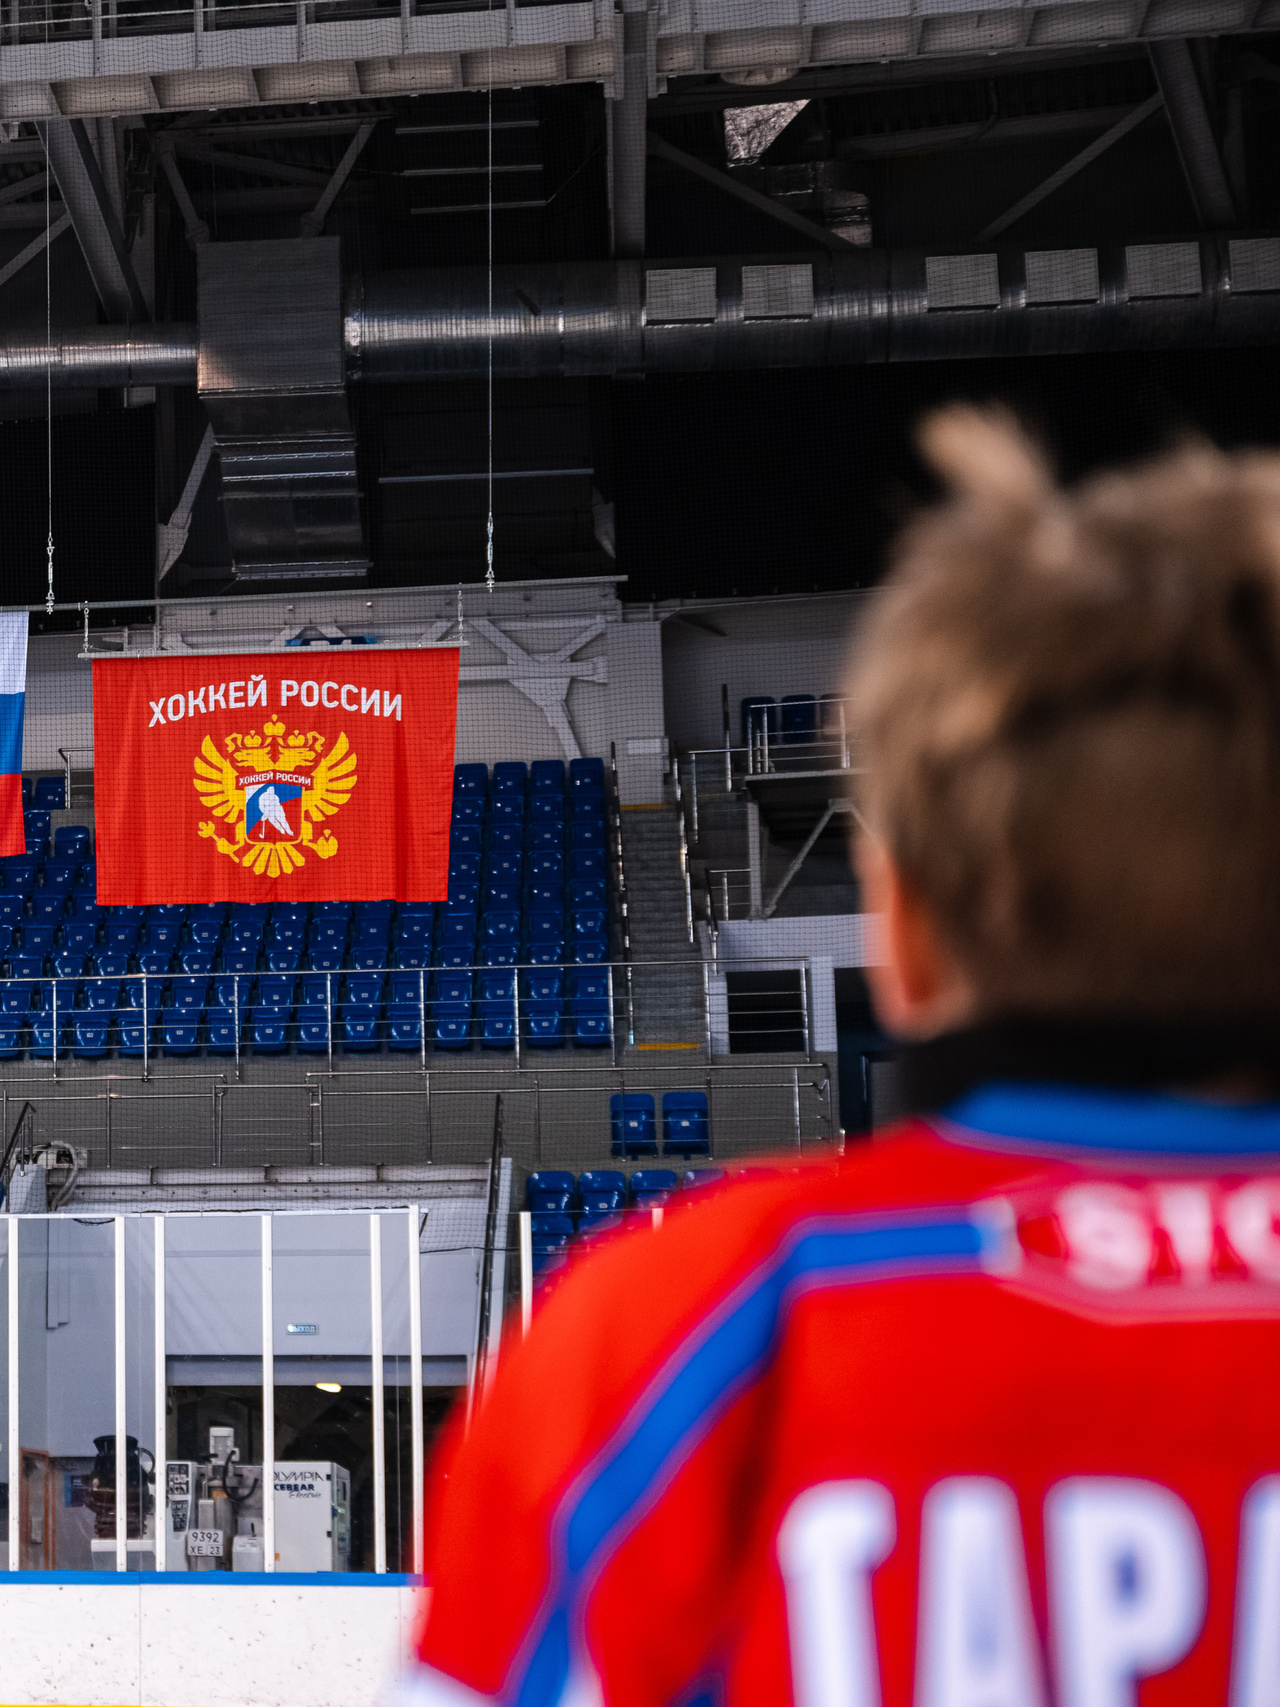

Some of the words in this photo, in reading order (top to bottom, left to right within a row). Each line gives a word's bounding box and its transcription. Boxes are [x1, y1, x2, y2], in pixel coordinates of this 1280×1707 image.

[148, 674, 267, 728] ХОККЕЙ
[281, 680, 402, 721] РОССИИ
[239, 771, 274, 786] ХОККЕЙ
[276, 772, 311, 786] РОССИИ
[274, 1483, 315, 1491] CEBEAR
[191, 1531, 220, 1543] 9392
[210, 1546, 221, 1555] 23
